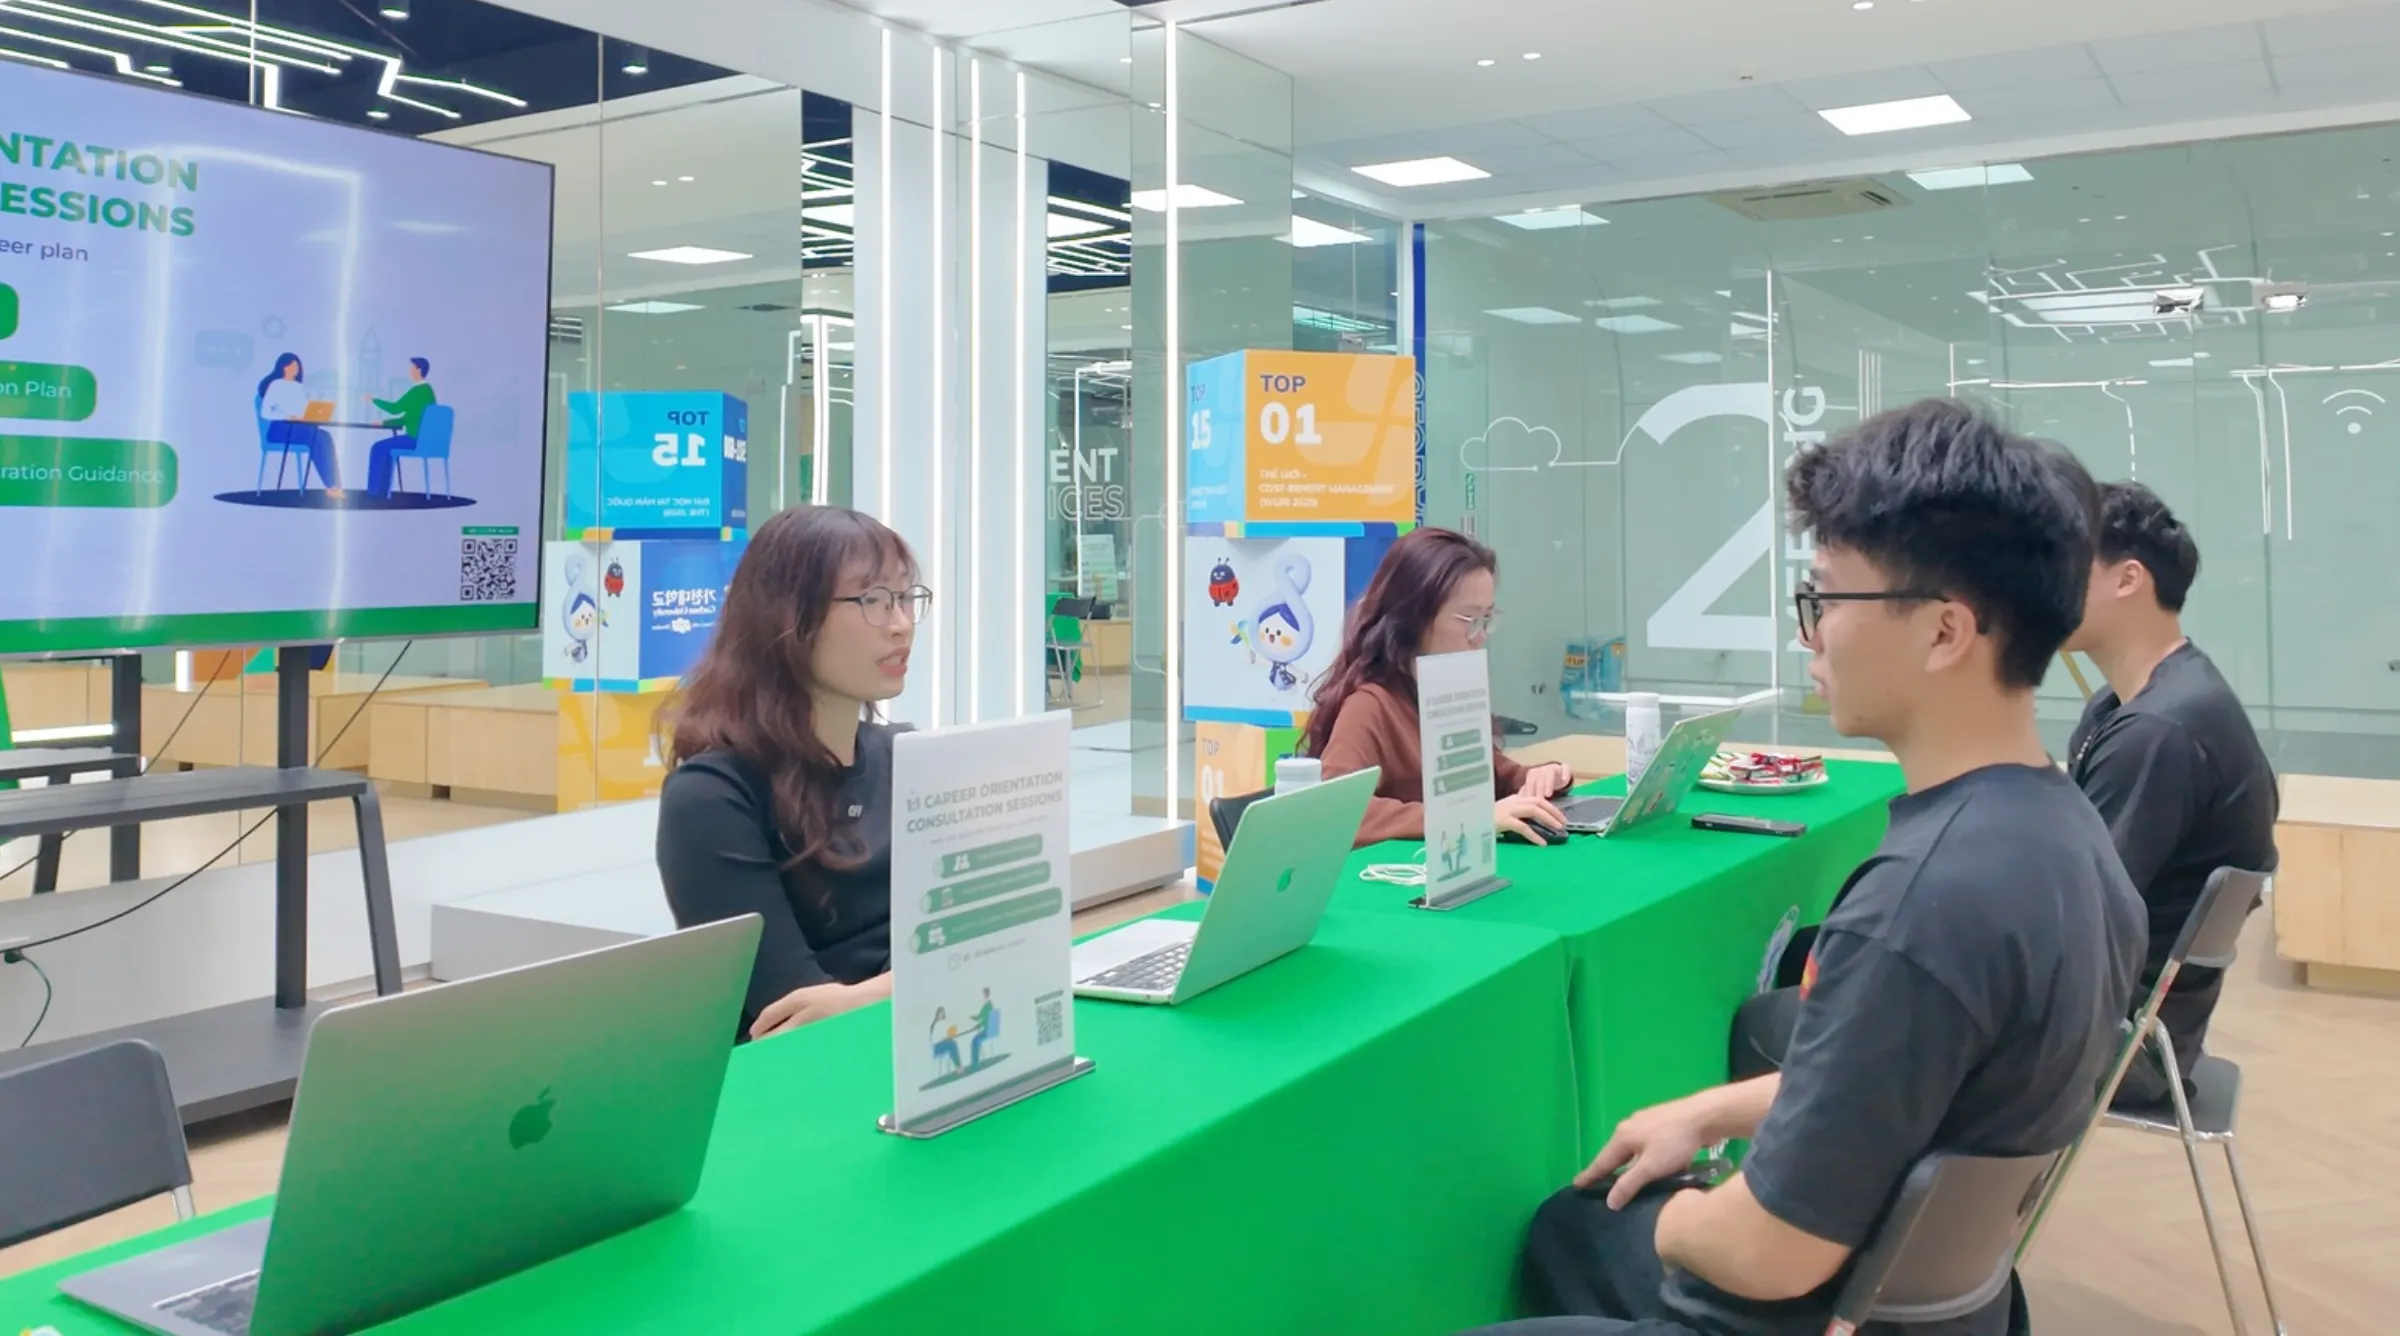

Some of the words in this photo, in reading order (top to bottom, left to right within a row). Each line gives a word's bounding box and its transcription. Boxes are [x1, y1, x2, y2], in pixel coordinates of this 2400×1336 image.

[0, 182, 195, 236] ESSIONS
[41, 242, 89, 262] plan
[25, 380, 72, 399] Plan
[1260, 374, 1306, 393] TOP
[1191, 408, 1212, 450] 15
[1260, 401, 1322, 445] 01
[68, 465, 165, 484] Guidance
[1202, 738, 1219, 756] TOP
[924, 787, 976, 809] CAREER
[980, 771, 1063, 798] ORIENTATION
[906, 801, 1003, 834] CONSULTATION
[1005, 789, 1063, 812] SESSIONS
